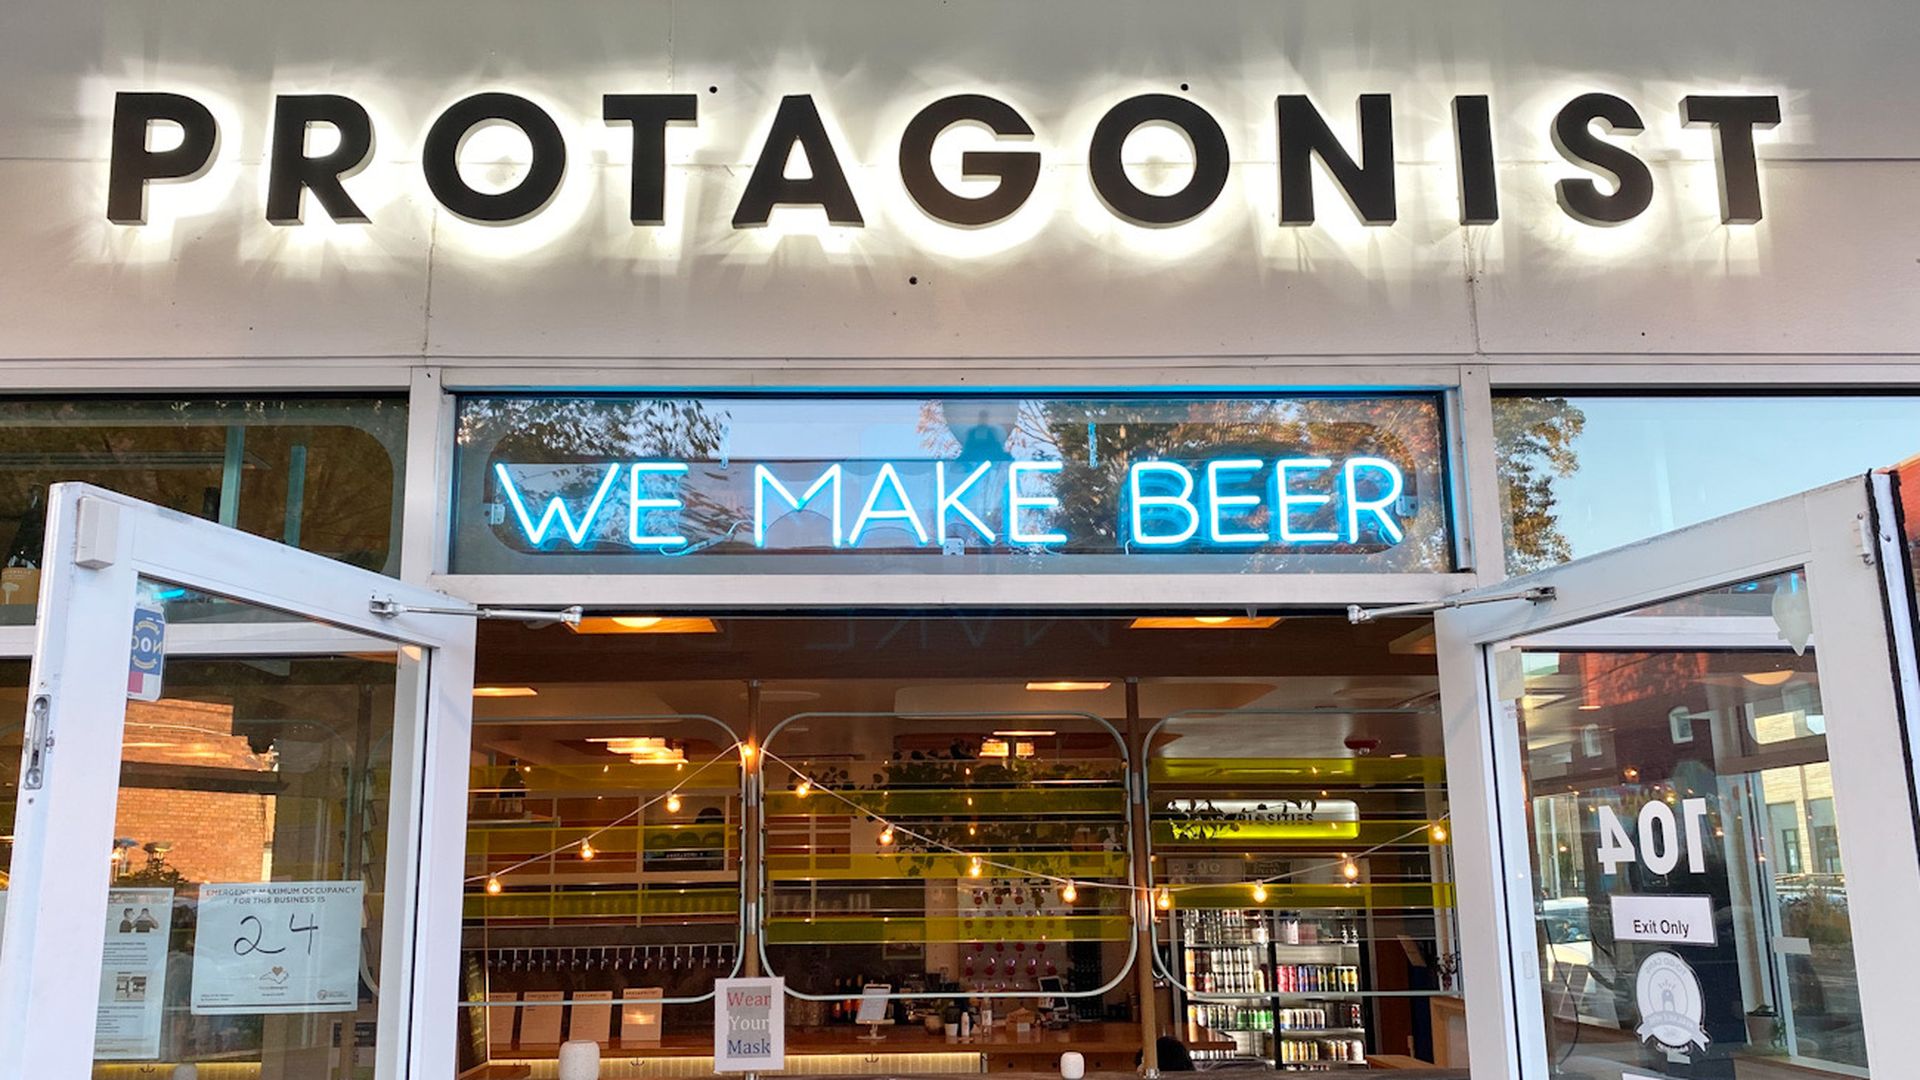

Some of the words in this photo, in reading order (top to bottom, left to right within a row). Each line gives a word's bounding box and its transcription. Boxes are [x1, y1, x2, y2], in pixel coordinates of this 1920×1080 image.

[106, 91, 1781, 228] PROTAGONIST
[494, 460, 690, 548] WE
[752, 460, 1068, 549] MAKE
[1127, 456, 1405, 546] BEER
[206, 889, 256, 897] EMERGENCY
[302, 886, 357, 895] OCCUPANCY
[233, 897, 251, 905] FOR
[253, 897, 272, 905] THIS
[274, 896, 316, 904] BUSINESS
[317, 896, 326, 904] IS
[233, 913, 319, 956] 24
[1633, 919, 1657, 934] Exit
[1660, 920, 1690, 938] Only
[727, 991, 771, 1007] Wear
[729, 1015, 769, 1031] Your
[728, 1038, 771, 1055] Mask
